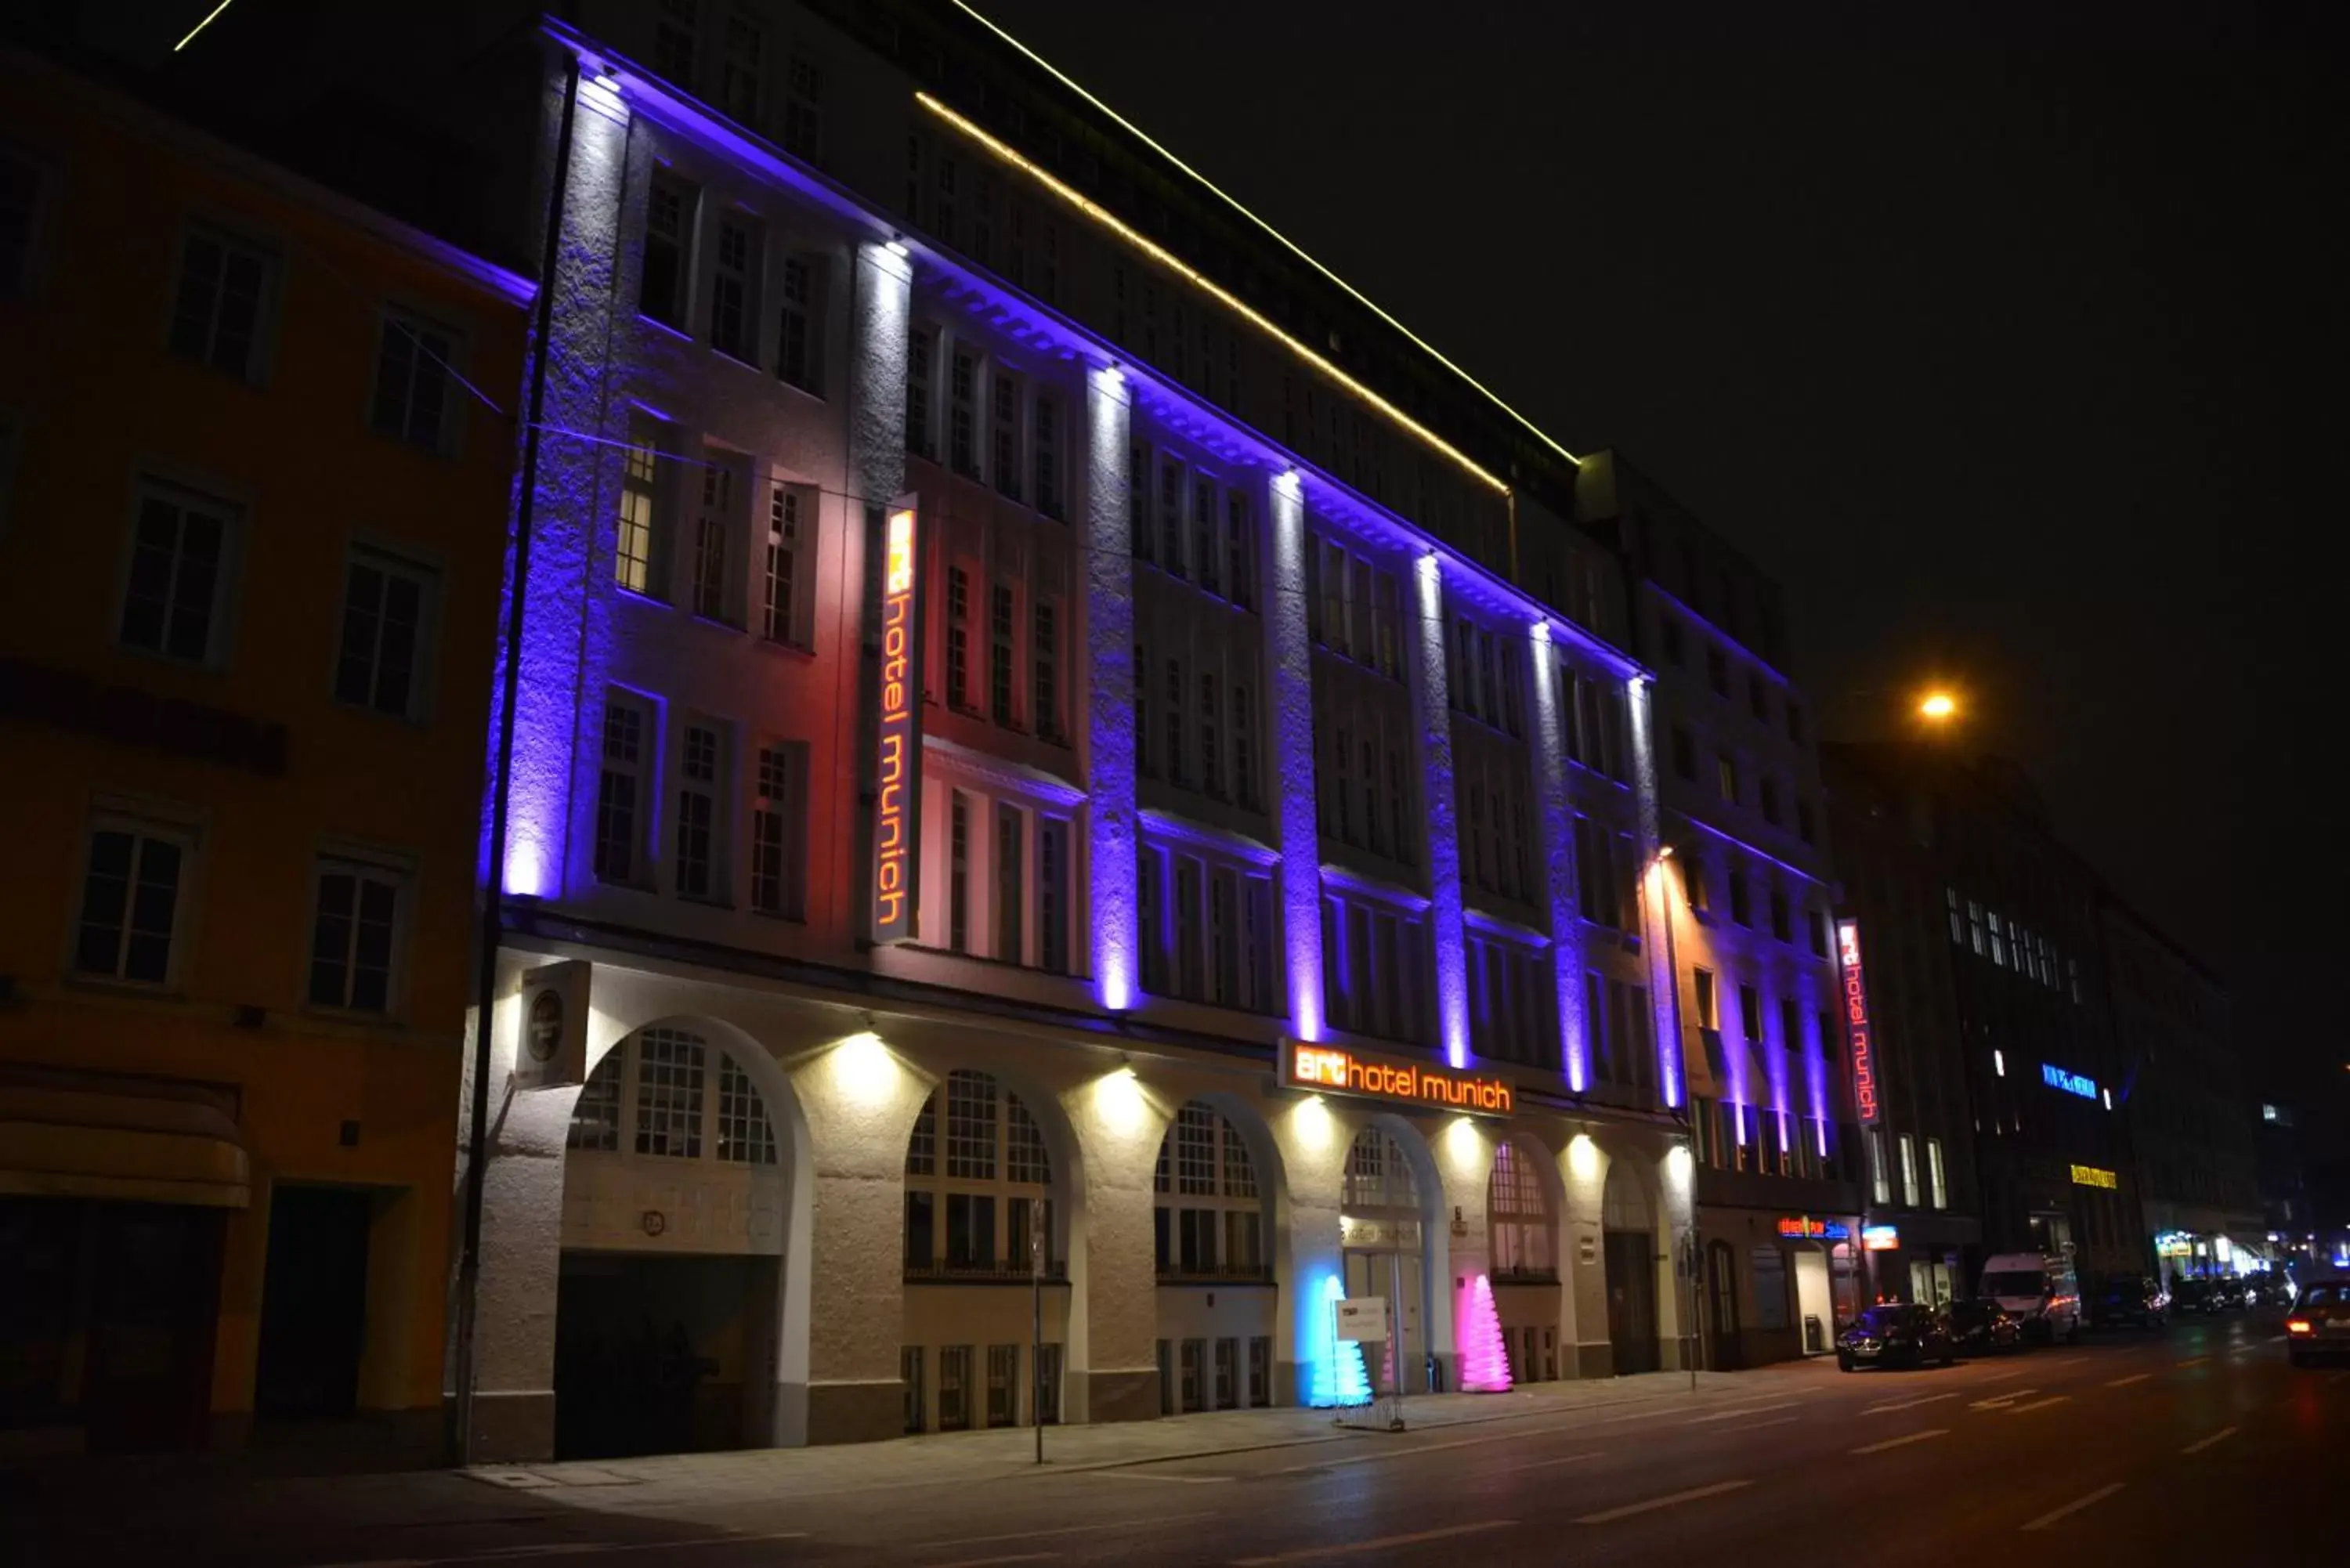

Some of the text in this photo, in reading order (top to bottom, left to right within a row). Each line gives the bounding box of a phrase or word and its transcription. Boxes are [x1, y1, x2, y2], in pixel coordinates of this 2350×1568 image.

[878, 735, 906, 926] munich
[1423, 1075, 1511, 1111] munich
[1854, 1032, 1878, 1119] munich
